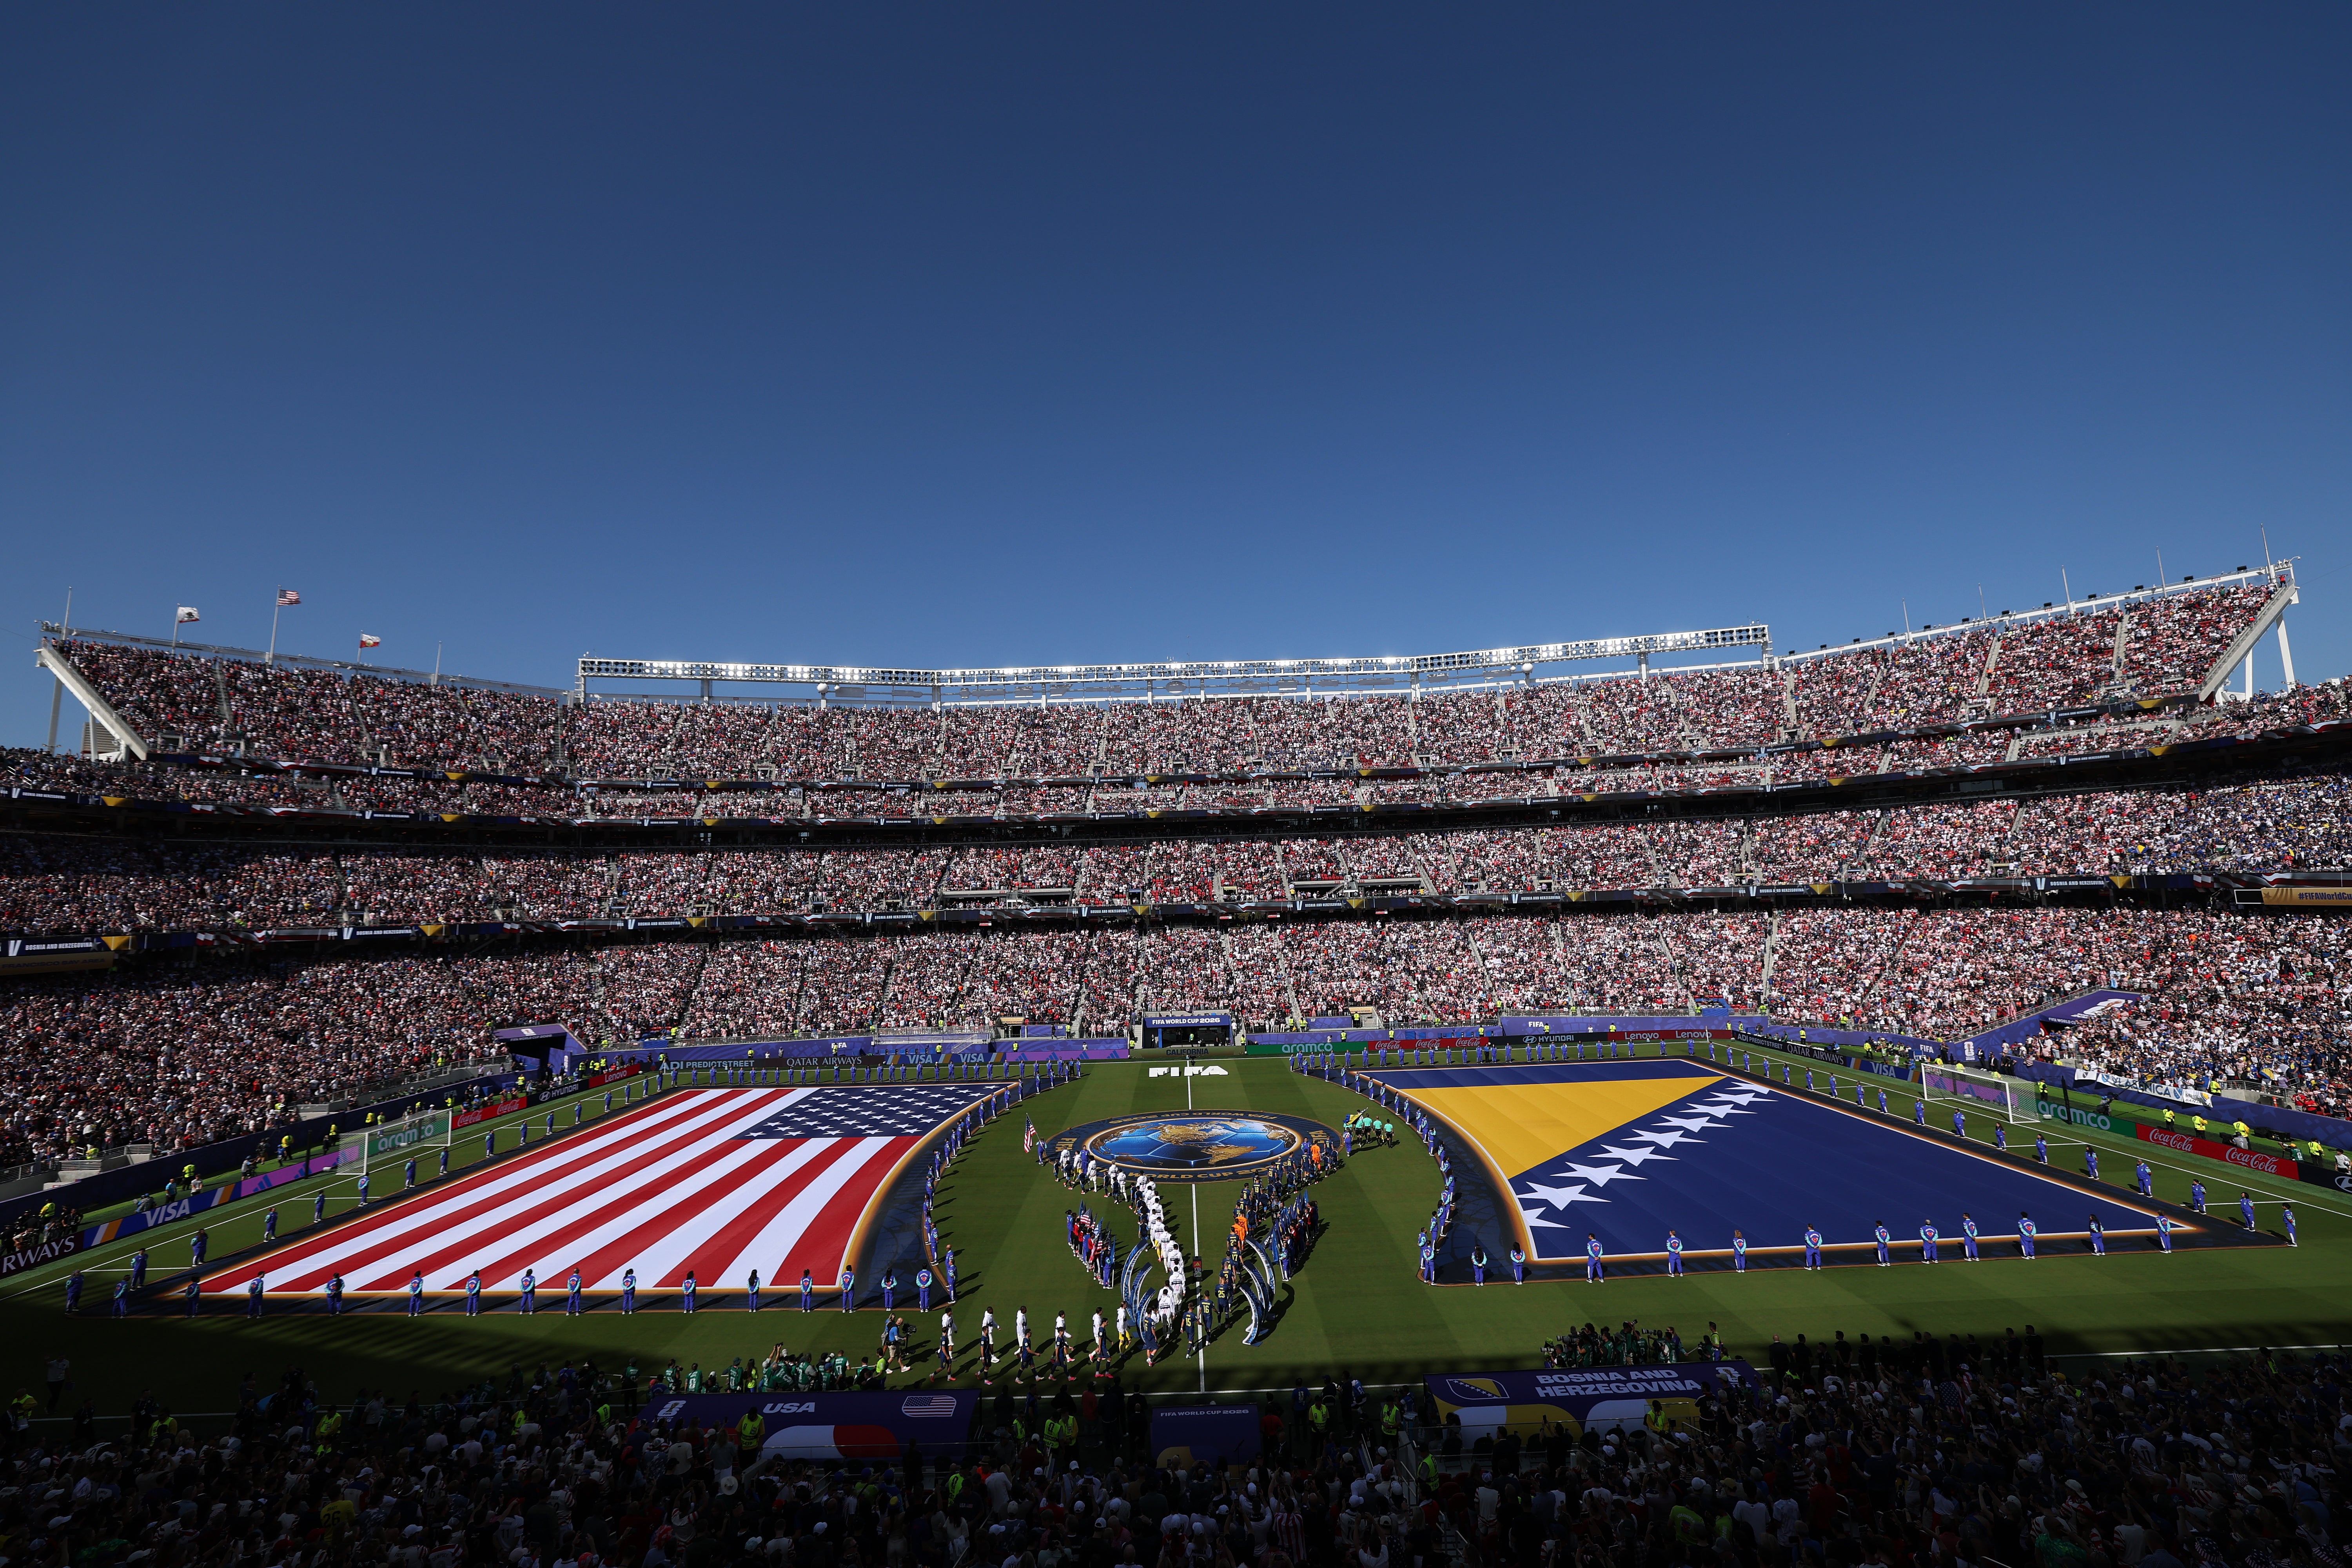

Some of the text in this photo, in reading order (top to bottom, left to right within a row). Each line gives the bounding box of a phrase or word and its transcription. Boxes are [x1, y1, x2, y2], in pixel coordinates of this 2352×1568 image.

[2034, 878, 2046, 890] V
[1749, 886, 1757, 897] V
[2298, 892, 2352, 900] #FIFAWorldCu
[1512, 894, 1519, 904] V
[1296, 901, 1303, 910] V
[1081, 907, 1088, 916] V
[865, 913, 873, 922] V
[627, 919, 635, 929] V
[342, 927, 354, 940] V
[8, 940, 22, 956] V
[1675, 1030, 1712, 1038] Lenovo
[1375, 1040, 1401, 1050] Coca-Cola
[1416, 1039, 1441, 1049] Coca-Cola
[1455, 1037, 1481, 1047] Coca-Cola
[1737, 1033, 1783, 1049] ADI PREDICTSTREET
[1281, 1043, 1333, 1053] aramco
[1920, 1044, 1935, 1054] FIFA
[907, 1054, 933, 1064] VISA
[958, 1053, 985, 1063] VISA
[1787, 1044, 1844, 1065] QATAR AIRWAYS
[659, 1060, 755, 1070] ADI PREDICTSTREET
[786, 1056, 862, 1067] QATAR AIRWAYS
[1149, 1065, 1228, 1078] FIFA
[1869, 1062, 1896, 1078] VISA
[605, 1070, 628, 1083] Lenovo
[552, 1082, 579, 1098] HYUNDAI
[497, 1099, 520, 1115] Coca-Cola
[457, 1109, 483, 1127] Coca-Cola
[1109, 1115, 1158, 1124] 2026
[2037, 1101, 2111, 1130] aramco
[1055, 1138, 1078, 1152] FIFA
[2149, 1128, 2194, 1152] Coca-Cola
[2226, 1147, 2279, 1173] Coca-Cola
[141, 1198, 190, 1227] VISA
[1218, 1290, 1225, 1298] 25
[1203, 1305, 1210, 1314] 16
[1145, 1323, 1149, 1332] 6
[1185, 1318, 1192, 1327] 15
[1536, 1369, 1679, 1384] BOSNIA AND
[1534, 1379, 1702, 1397] HERZEGOVINA
[762, 1402, 816, 1414] USA
[323, 1511, 341, 1528] 26
[501, 1529, 510, 1538] 11
